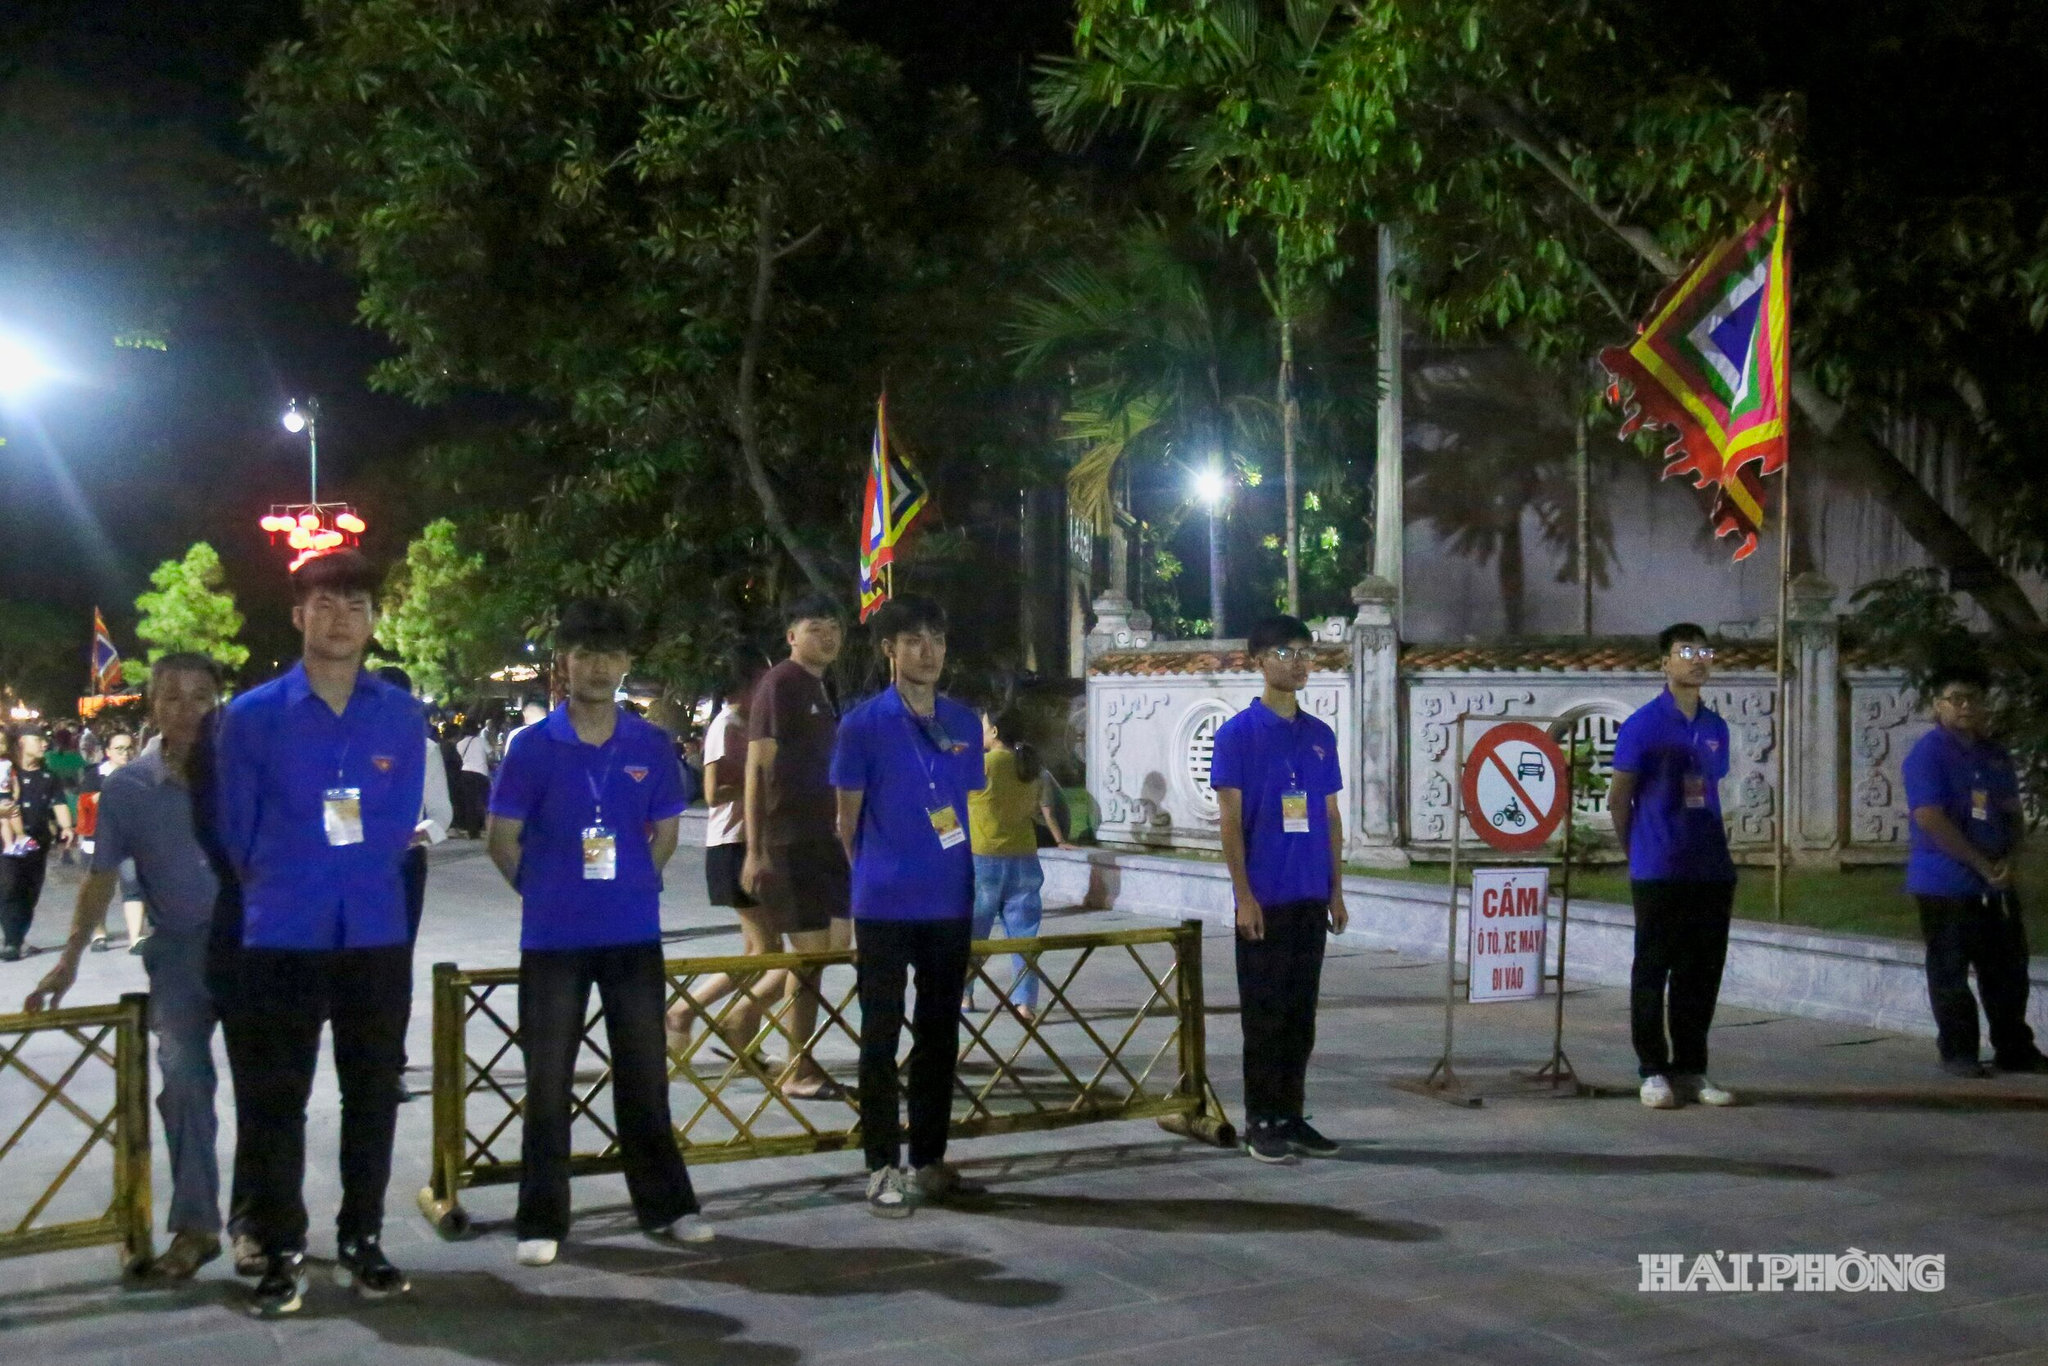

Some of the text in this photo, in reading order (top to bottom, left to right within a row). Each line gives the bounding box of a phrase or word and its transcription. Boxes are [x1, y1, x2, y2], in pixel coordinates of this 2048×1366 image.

[1482, 877, 1538, 918] CẤM
[1477, 928, 1485, 955] Ô
[1504, 931, 1516, 954] XE
[1519, 925, 1544, 953] MÁY
[1492, 962, 1524, 990] ĐI VÀO
